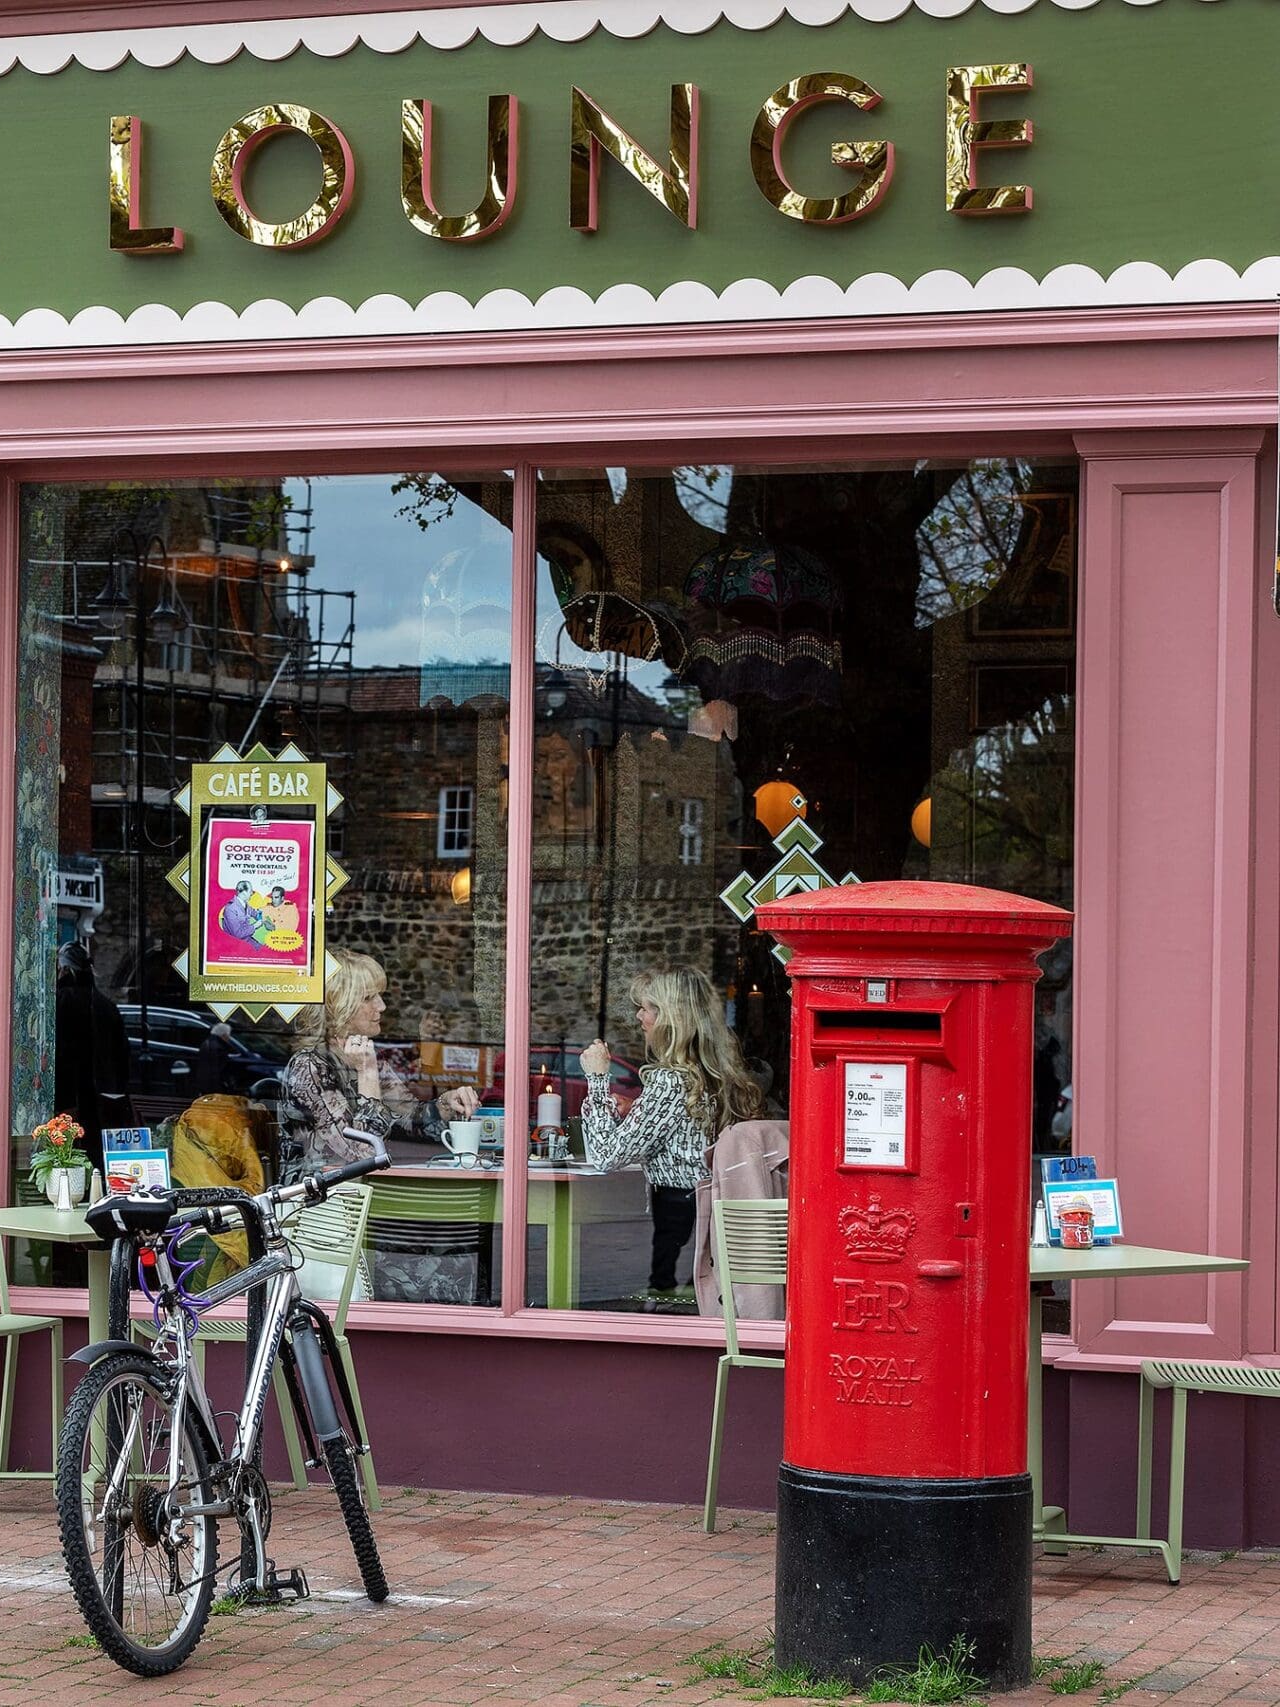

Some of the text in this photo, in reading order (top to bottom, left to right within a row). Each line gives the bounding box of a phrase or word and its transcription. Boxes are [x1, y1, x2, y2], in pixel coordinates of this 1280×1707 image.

[108, 62, 1038, 256] LOUNGE
[208, 767, 309, 798] CAFÉ BAR
[224, 844, 295, 854] COCKTAILS
[254, 854, 292, 862] TWO?
[204, 983, 308, 993] WWW.THELOUNGES.CO.UK
[116, 1130, 142, 1144] 103
[1059, 1158, 1089, 1175] 104
[252, 1309, 286, 1428] DIAMONDBACK
[828, 1352, 924, 1382] ROYAL
[836, 1379, 913, 1408] MAIL
